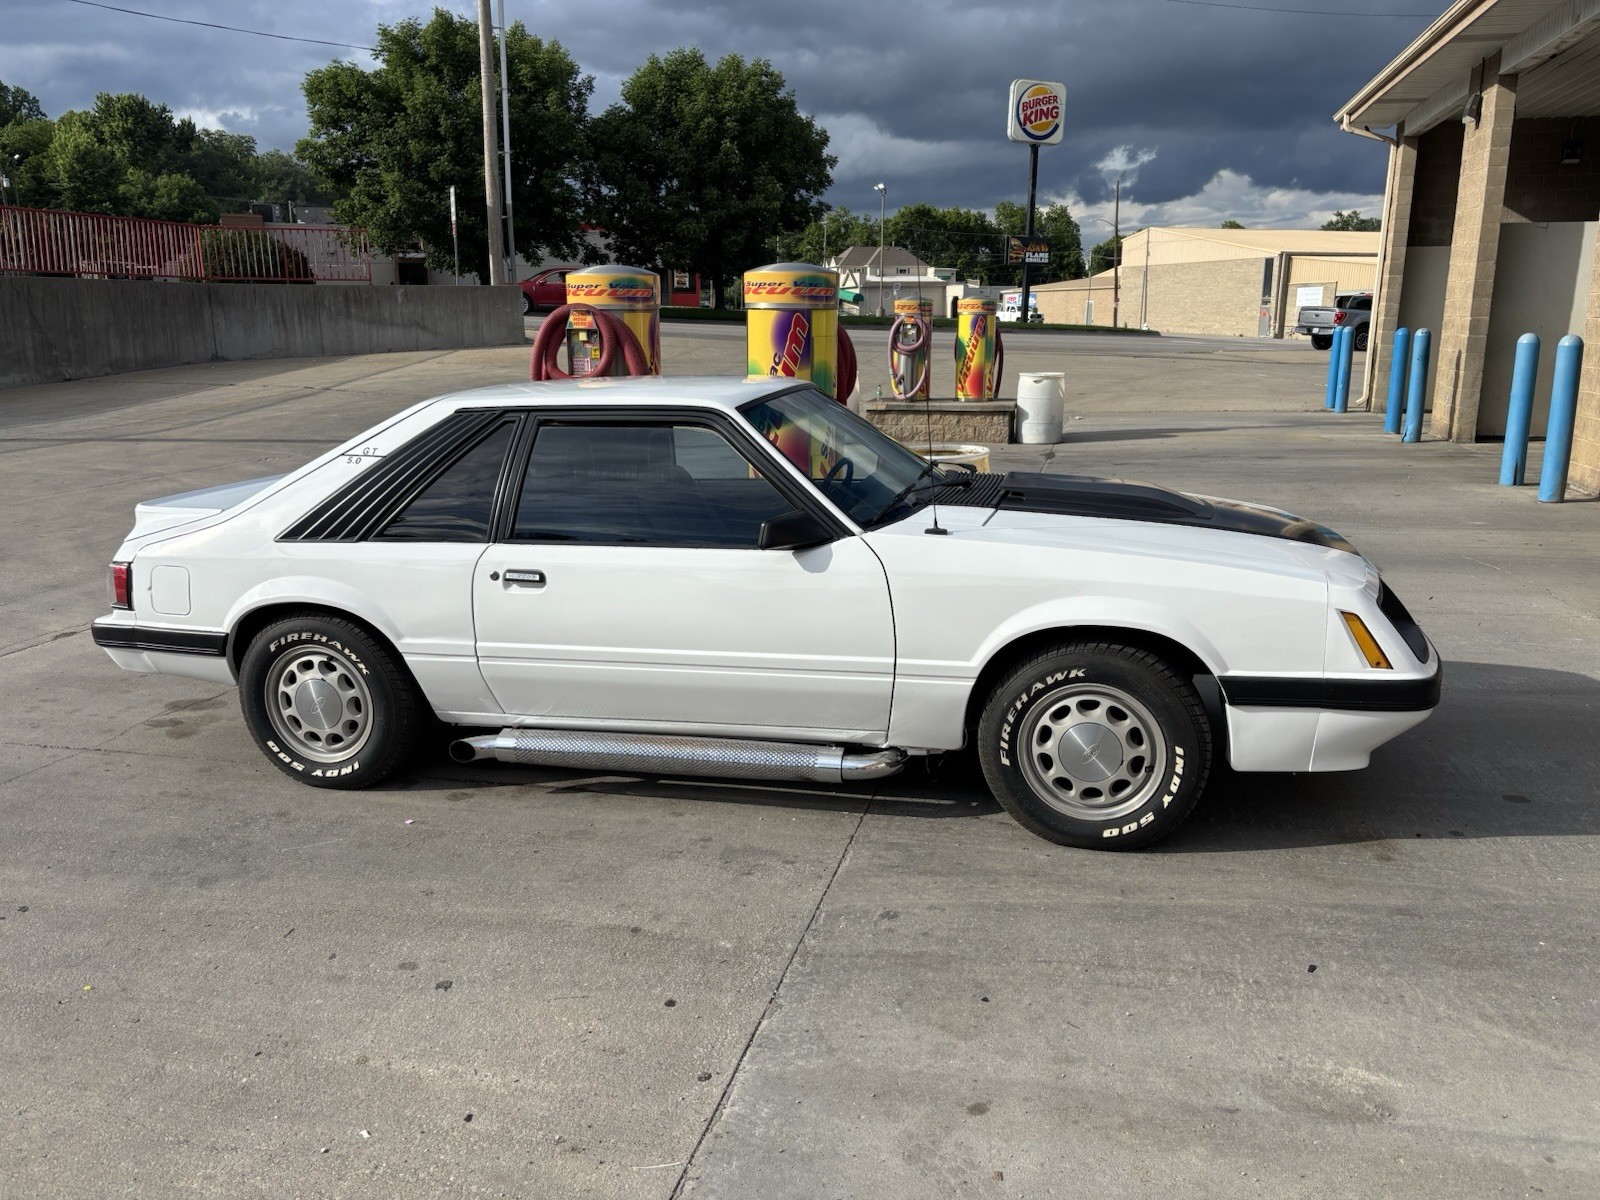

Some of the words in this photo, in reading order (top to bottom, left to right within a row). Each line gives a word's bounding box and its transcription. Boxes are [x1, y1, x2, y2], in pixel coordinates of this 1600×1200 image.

[1022, 95, 1059, 112] BURGER
[1022, 106, 1060, 127] KING
[566, 288, 653, 297] acuum
[744, 287, 834, 296] acuum
[363, 447, 378, 455] GT
[269, 632, 371, 676] FIREHAWK
[1000, 668, 1087, 767] FIREHAWK
[266, 740, 306, 772] 500
[311, 761, 360, 777] INDY
[1162, 746, 1185, 809] INDY
[1102, 811, 1155, 838] 500
